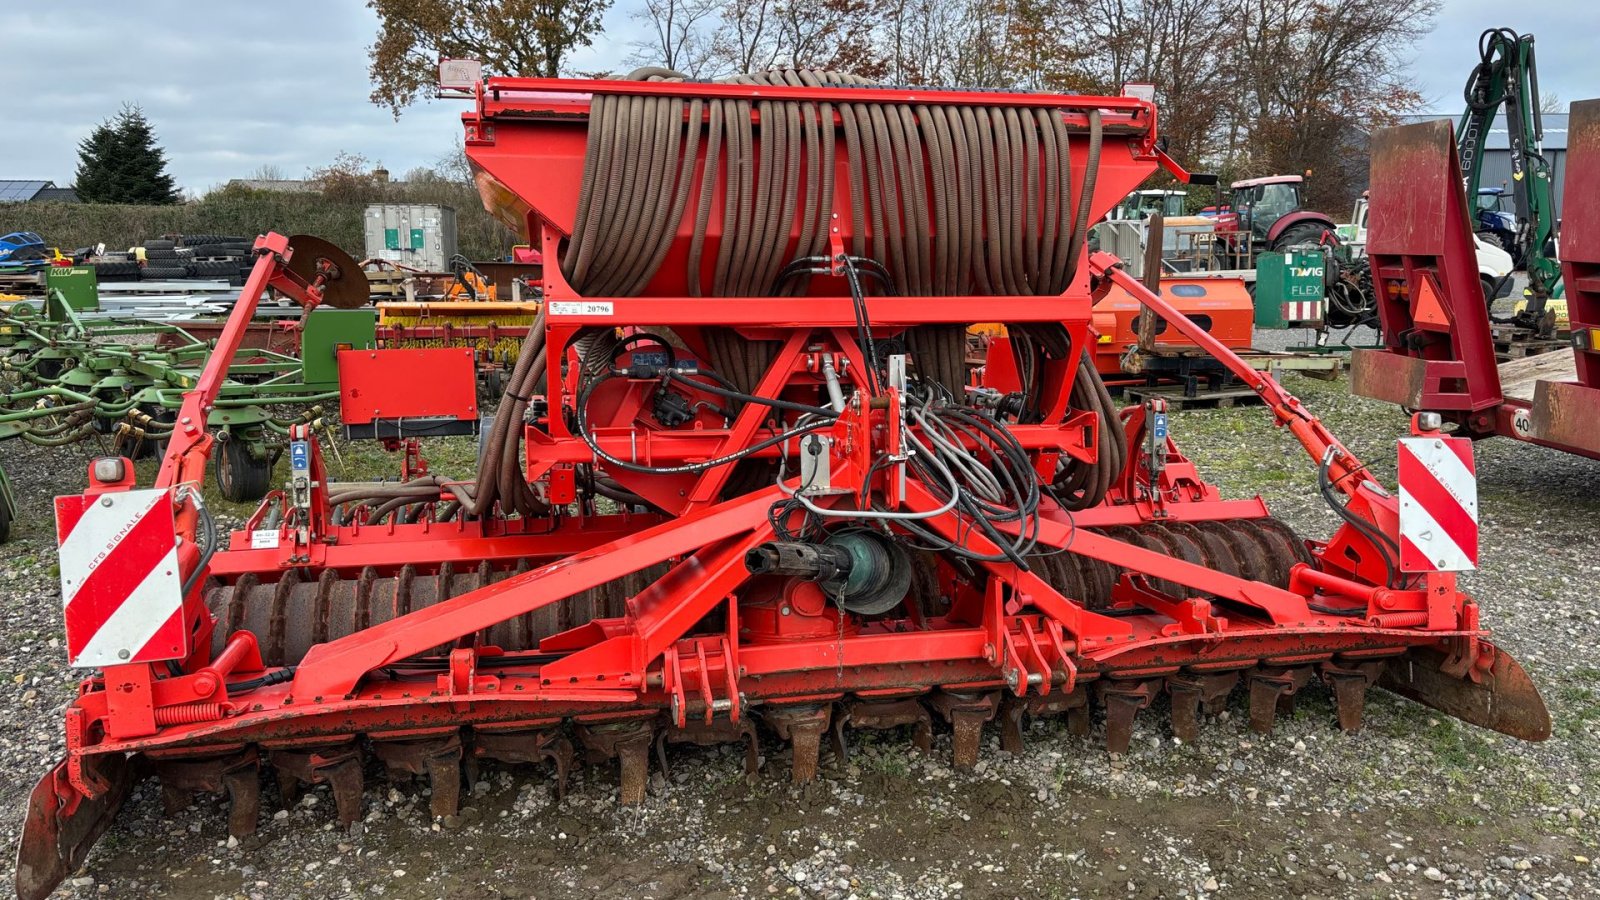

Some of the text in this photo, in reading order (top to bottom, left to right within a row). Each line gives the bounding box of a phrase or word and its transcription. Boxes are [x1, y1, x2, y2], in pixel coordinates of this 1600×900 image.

[1461, 120, 1480, 170] 6000T
[1289, 267, 1323, 277] TWIG
[1291, 285, 1320, 295] FLEX
[587, 305, 610, 313] 20796
[1515, 417, 1529, 432] 40
[1439, 476, 1464, 504] SGNALE
[88, 511, 143, 570] CFG SIGNALE
